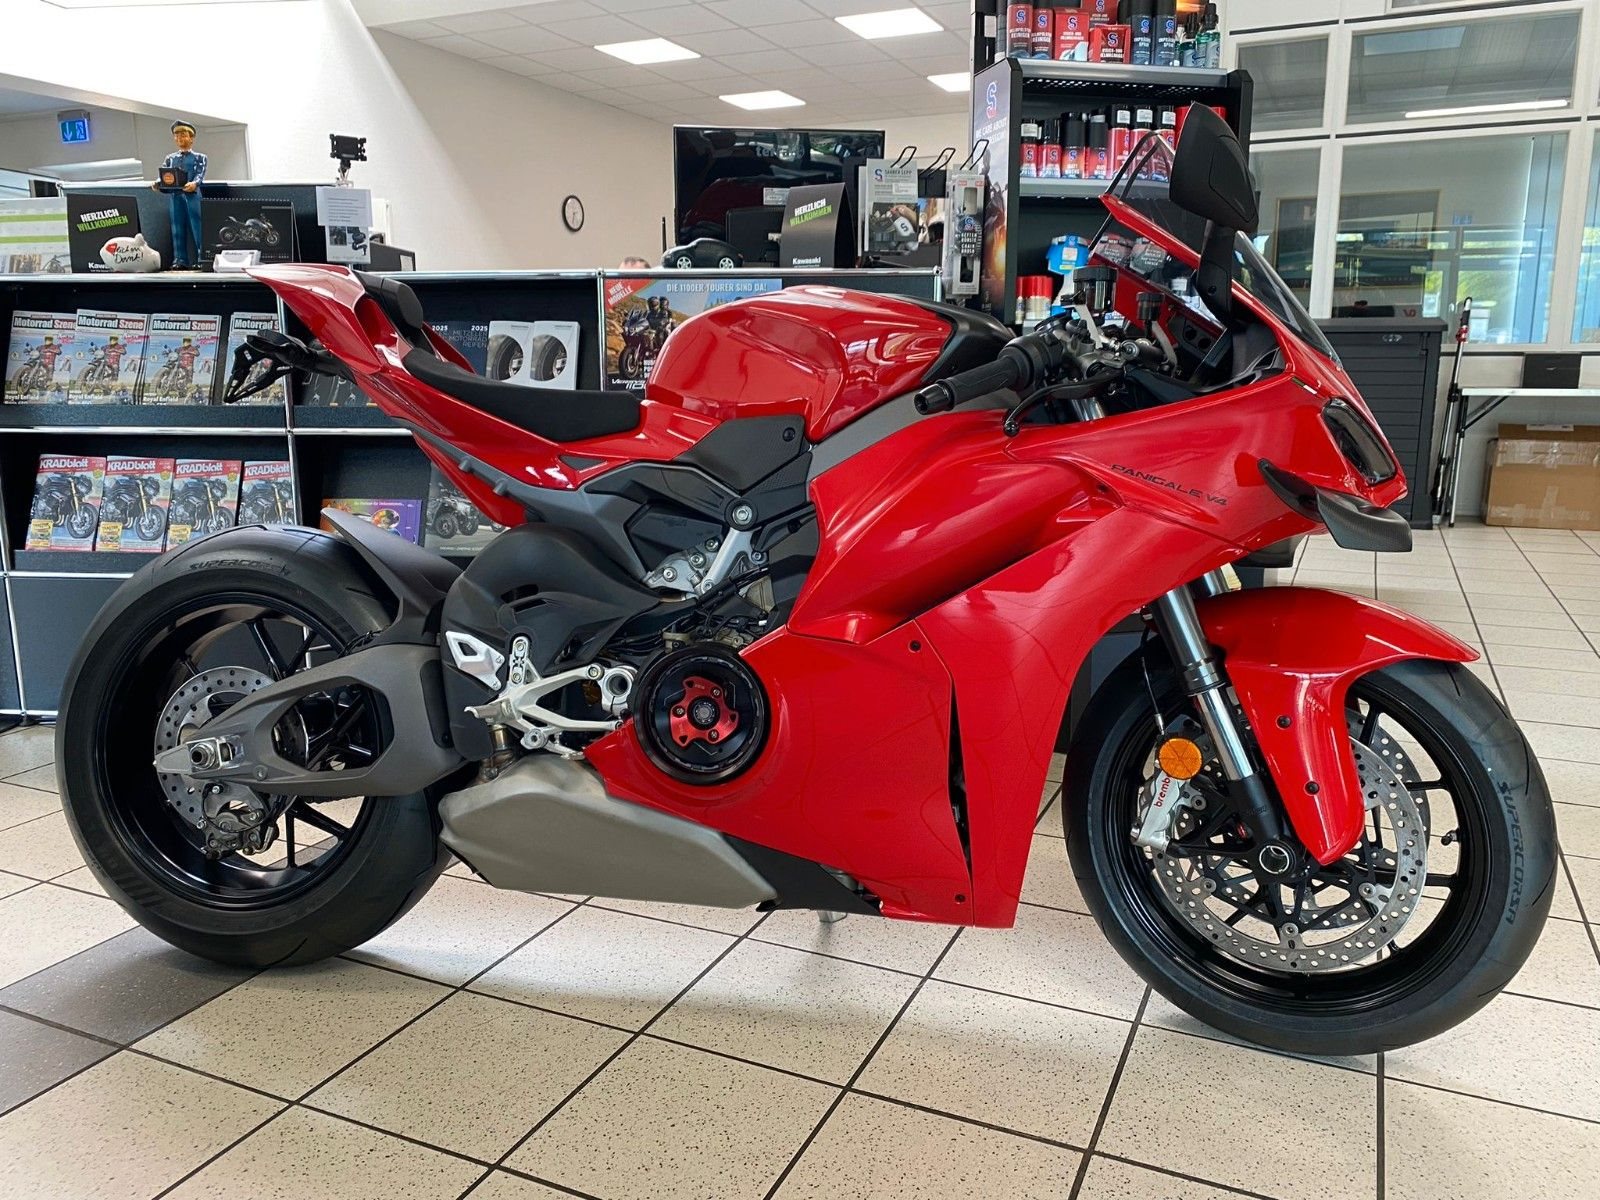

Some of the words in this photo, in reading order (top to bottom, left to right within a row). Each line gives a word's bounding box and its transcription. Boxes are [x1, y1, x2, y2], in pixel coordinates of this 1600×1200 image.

[794, 198, 827, 216] HERZLICH
[80, 208, 120, 222] HERZLICH
[789, 204, 832, 227] WILLKOMMEN
[76, 215, 129, 232] WILLKOMMEN
[792, 256, 822, 266] Kawasaki
[608, 281, 625, 296] NEUE
[666, 283, 679, 292] DIE
[706, 283, 734, 292] TOURER
[735, 283, 753, 292] SIND
[754, 283, 768, 291] DA!
[607, 285, 634, 306] MODELLE
[14, 317, 53, 328] Motorrad
[78, 315, 118, 328] Motorrad
[119, 319, 144, 330] Szene
[153, 319, 191, 330] Motorrad
[191, 320, 217, 331] Szene
[234, 319, 273, 329] Motorrad
[39, 458, 89, 469] KRADblatt
[107, 460, 156, 471] KRADblatt
[176, 462, 223, 474] KRADblatt
[245, 464, 290, 476] KRADblatt
[1111, 463, 1204, 499] PANIGALE
[1205, 493, 1228, 506] V4
[1153, 775, 1171, 808] bremb
[1497, 780, 1526, 926] SUPERCORSA
